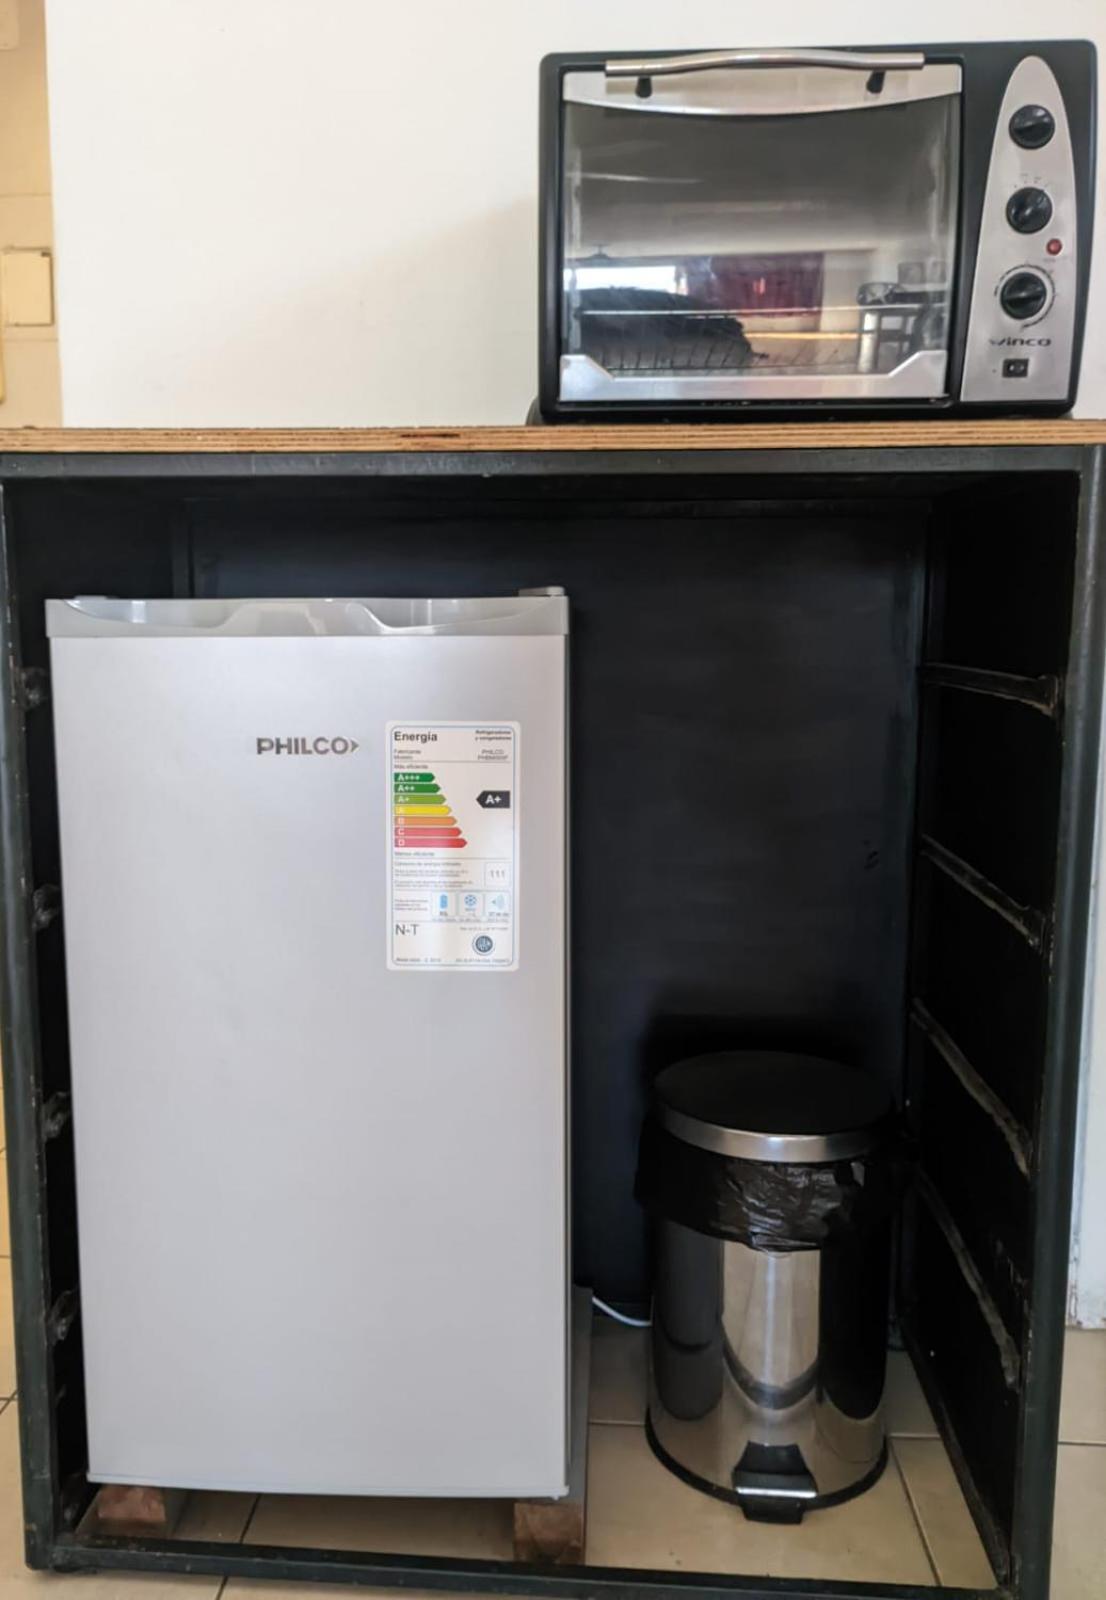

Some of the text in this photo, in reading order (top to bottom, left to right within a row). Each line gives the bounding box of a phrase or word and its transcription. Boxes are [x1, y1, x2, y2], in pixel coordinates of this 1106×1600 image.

[256, 736, 350, 755] PHILCO
[398, 784, 415, 792] A++
[485, 794, 502, 804] A+
[395, 924, 419, 935] N-T
